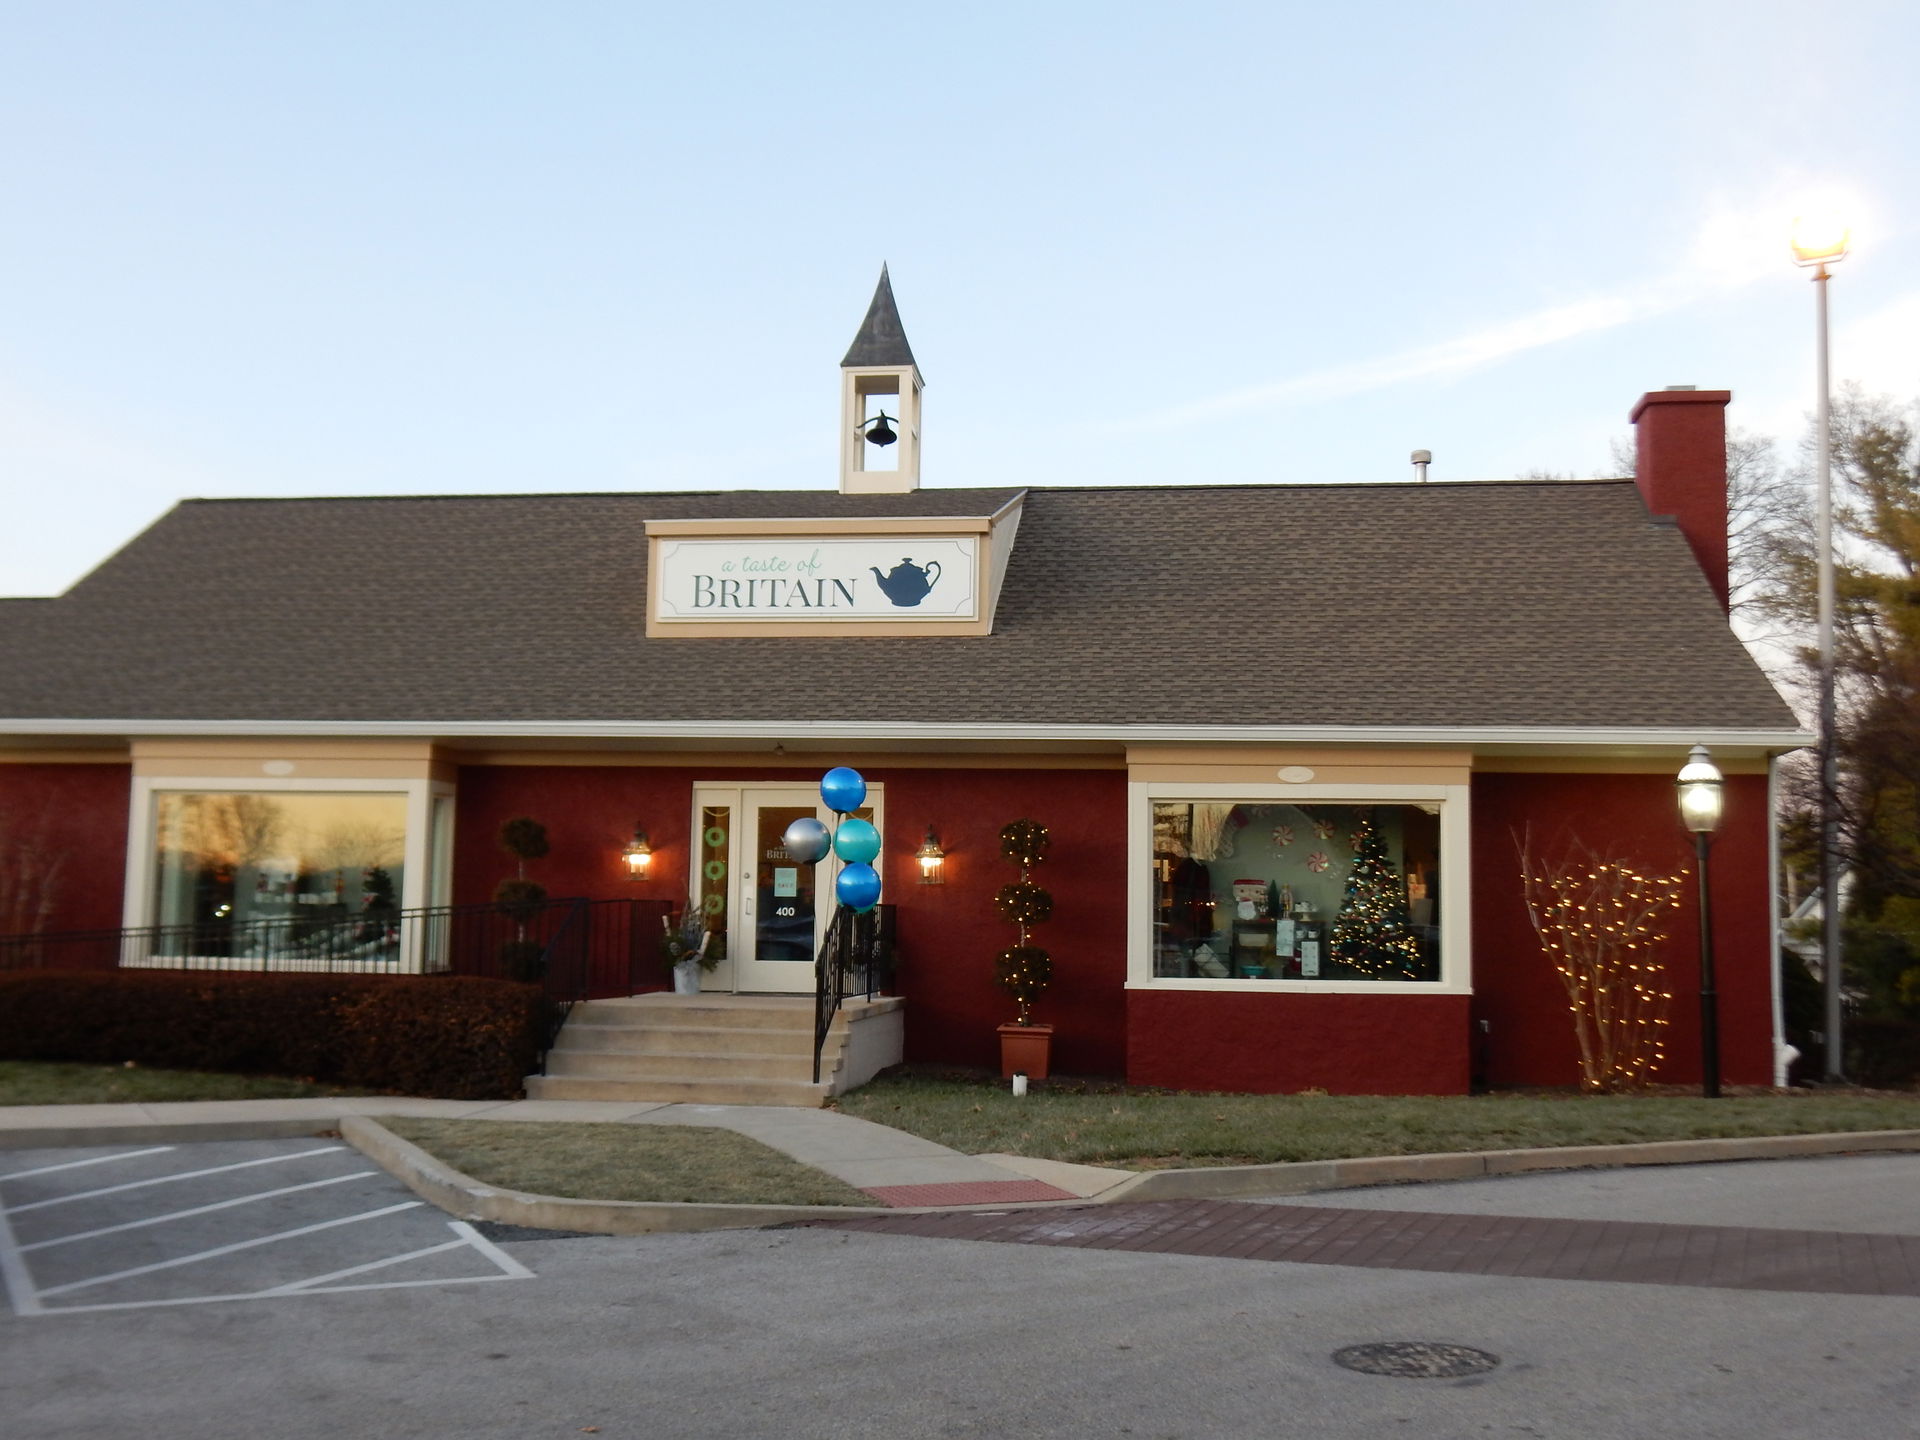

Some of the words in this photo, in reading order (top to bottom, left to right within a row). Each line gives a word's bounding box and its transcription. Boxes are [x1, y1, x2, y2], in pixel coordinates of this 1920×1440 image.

[721, 560, 736, 573] a
[742, 556, 791, 573] taste
[796, 548, 822, 577] of
[692, 574, 858, 609] BRITAIN
[766, 849, 792, 860] BRIT
[775, 907, 796, 917] 400
